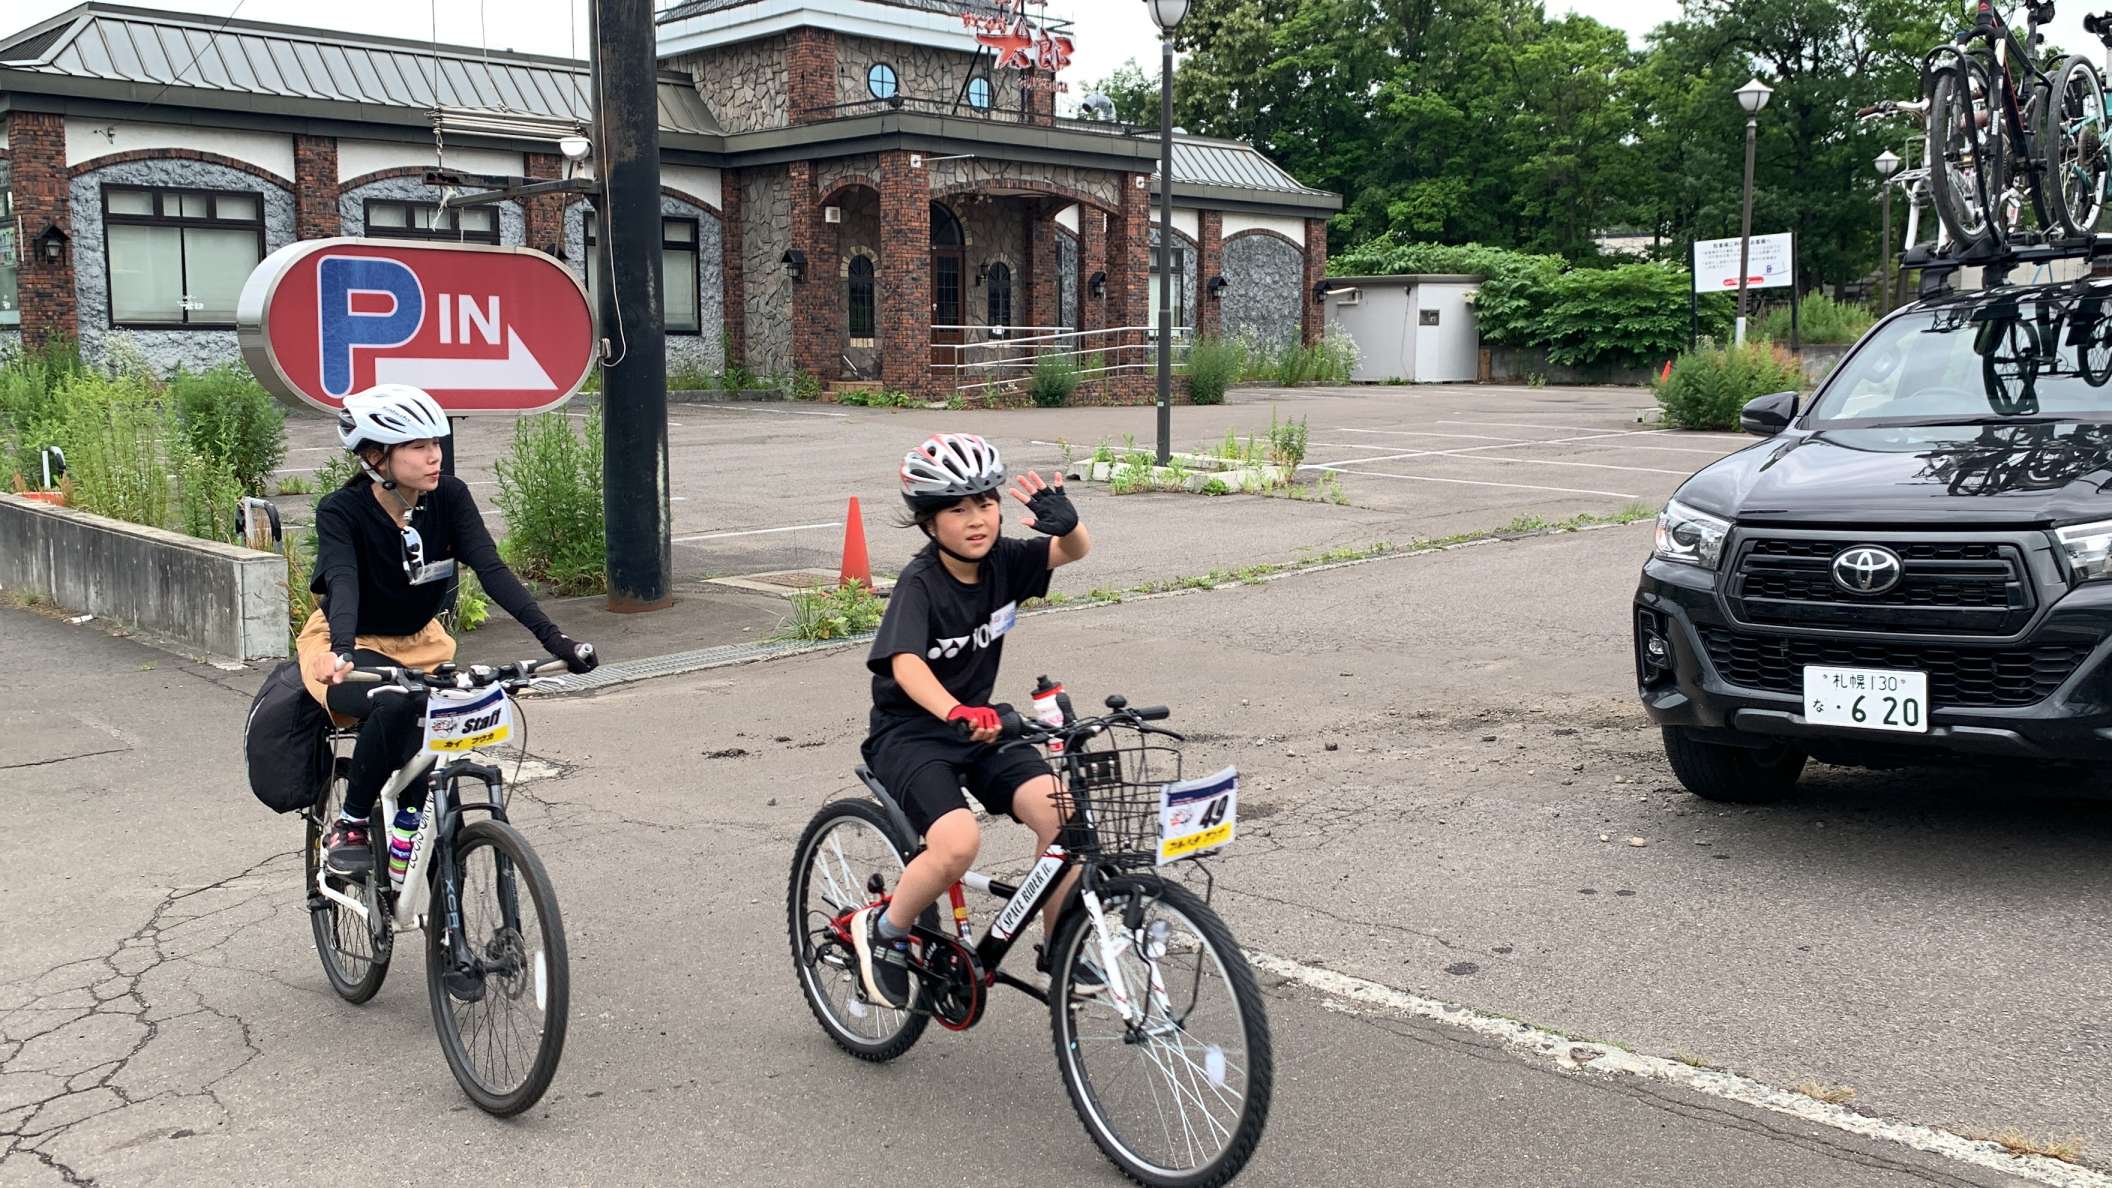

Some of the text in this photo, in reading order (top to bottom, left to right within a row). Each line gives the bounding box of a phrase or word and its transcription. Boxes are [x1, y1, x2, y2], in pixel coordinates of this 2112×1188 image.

[317, 255, 501, 398] P IN
[1832, 673, 1898, 692] 札幌 130
[1812, 698, 1825, 713] な
[1199, 794, 1229, 829] 49
[445, 879, 460, 928] XCR
[1003, 898, 1025, 928] SPACE
[1020, 871, 1045, 903] RIDER
